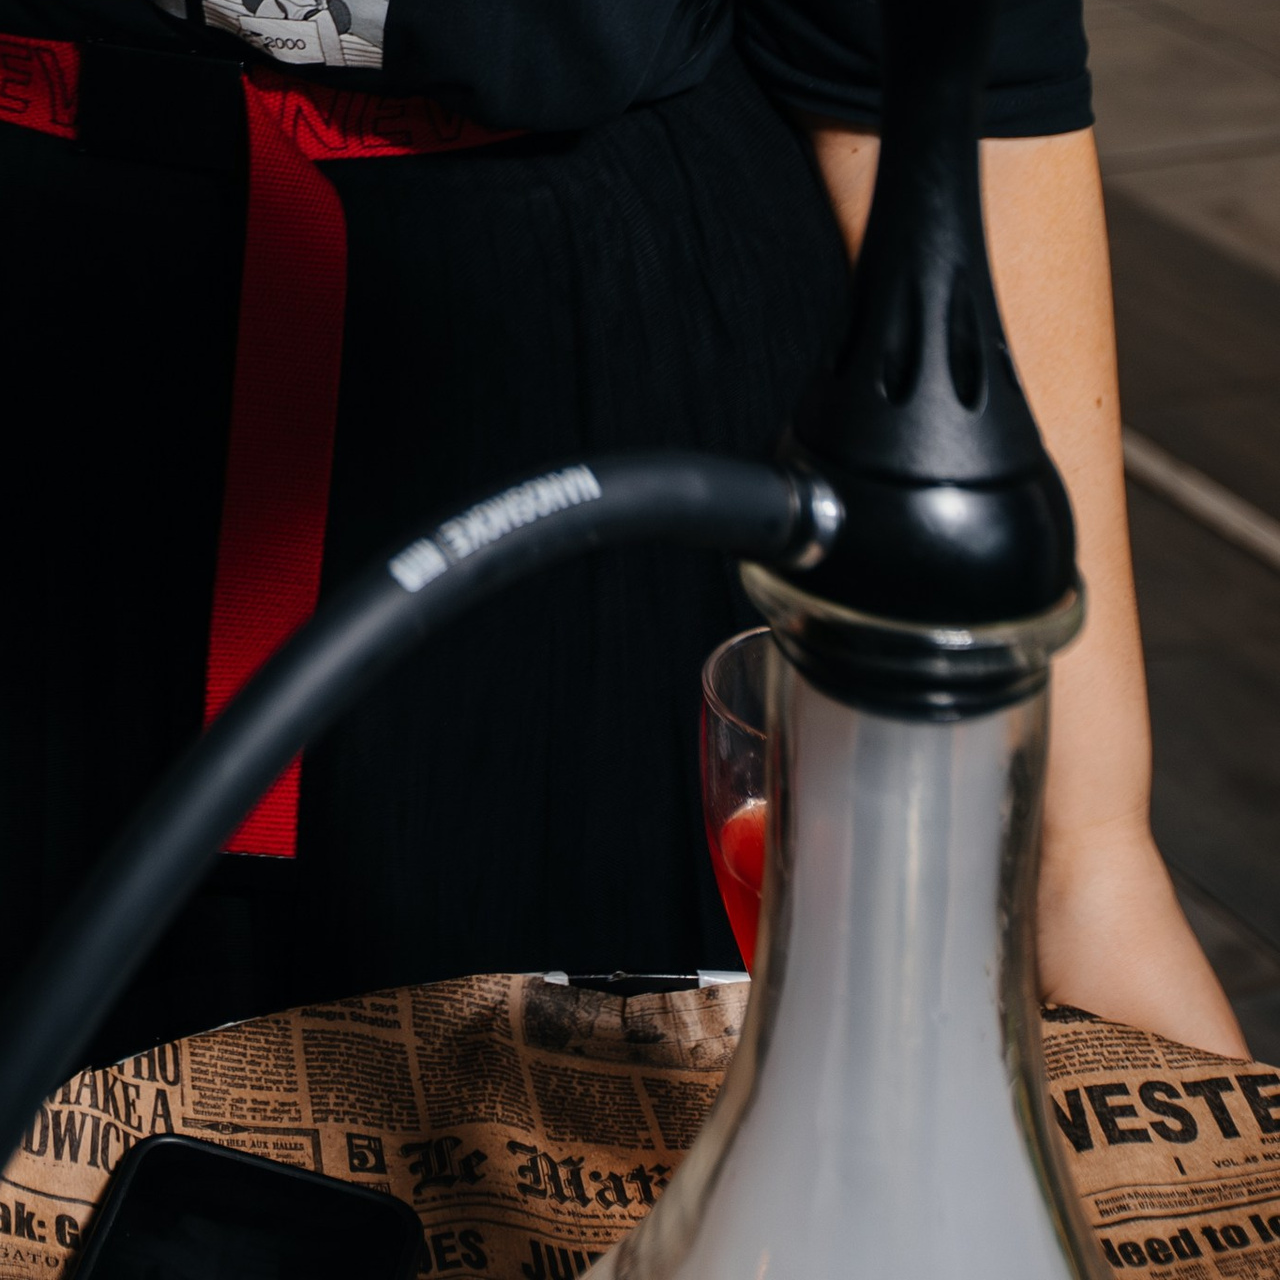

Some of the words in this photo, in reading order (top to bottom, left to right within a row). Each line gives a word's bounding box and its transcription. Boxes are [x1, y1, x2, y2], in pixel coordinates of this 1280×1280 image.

[263, 36, 307, 50] 2000
[148, 1087, 175, 1135] A
[250, 1141, 269, 1150] AUX
[398, 1138, 489, 1197] Le
[1201, 1225, 1251, 1253] to
